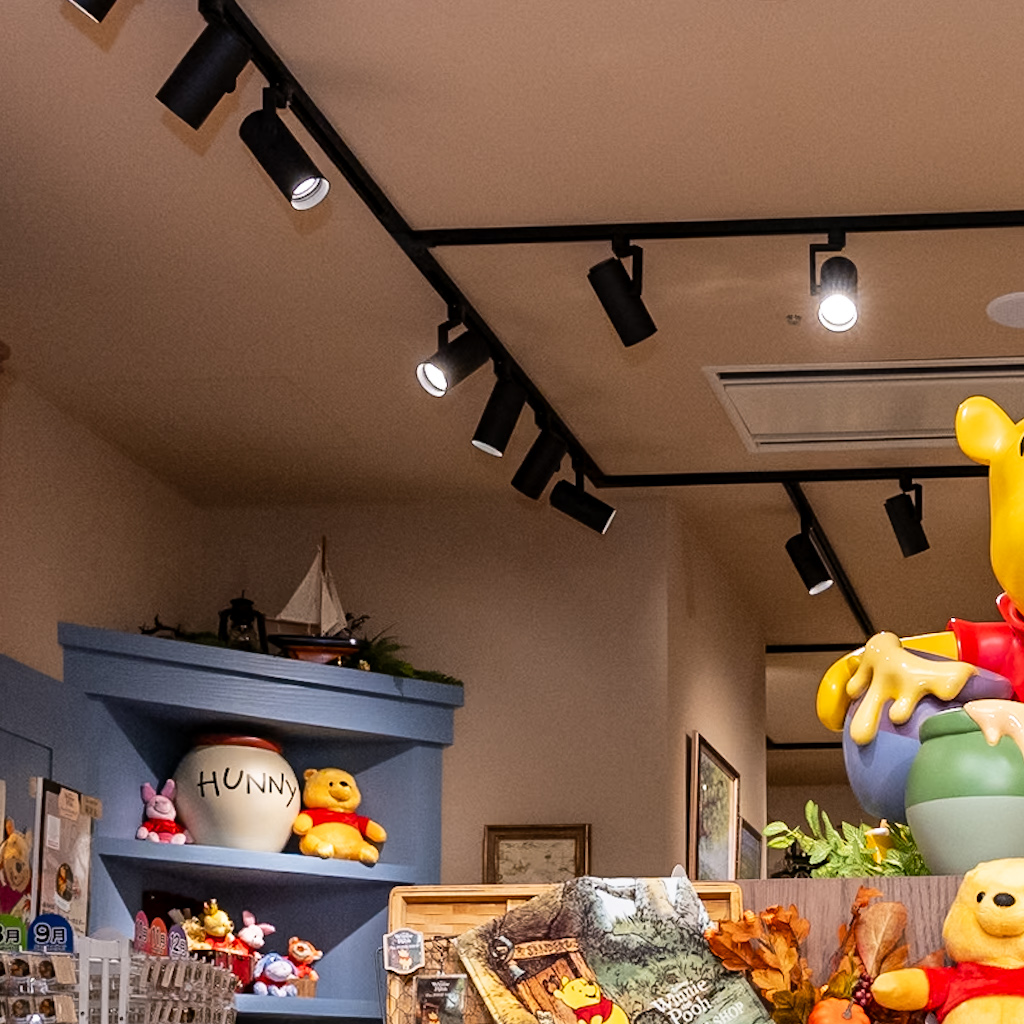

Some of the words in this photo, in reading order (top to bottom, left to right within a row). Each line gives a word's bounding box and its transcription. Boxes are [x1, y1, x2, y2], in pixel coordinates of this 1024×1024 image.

[197, 767, 297, 807] HUNNY
[34, 923, 67, 943] 9月
[651, 980, 708, 1014] Winnie
